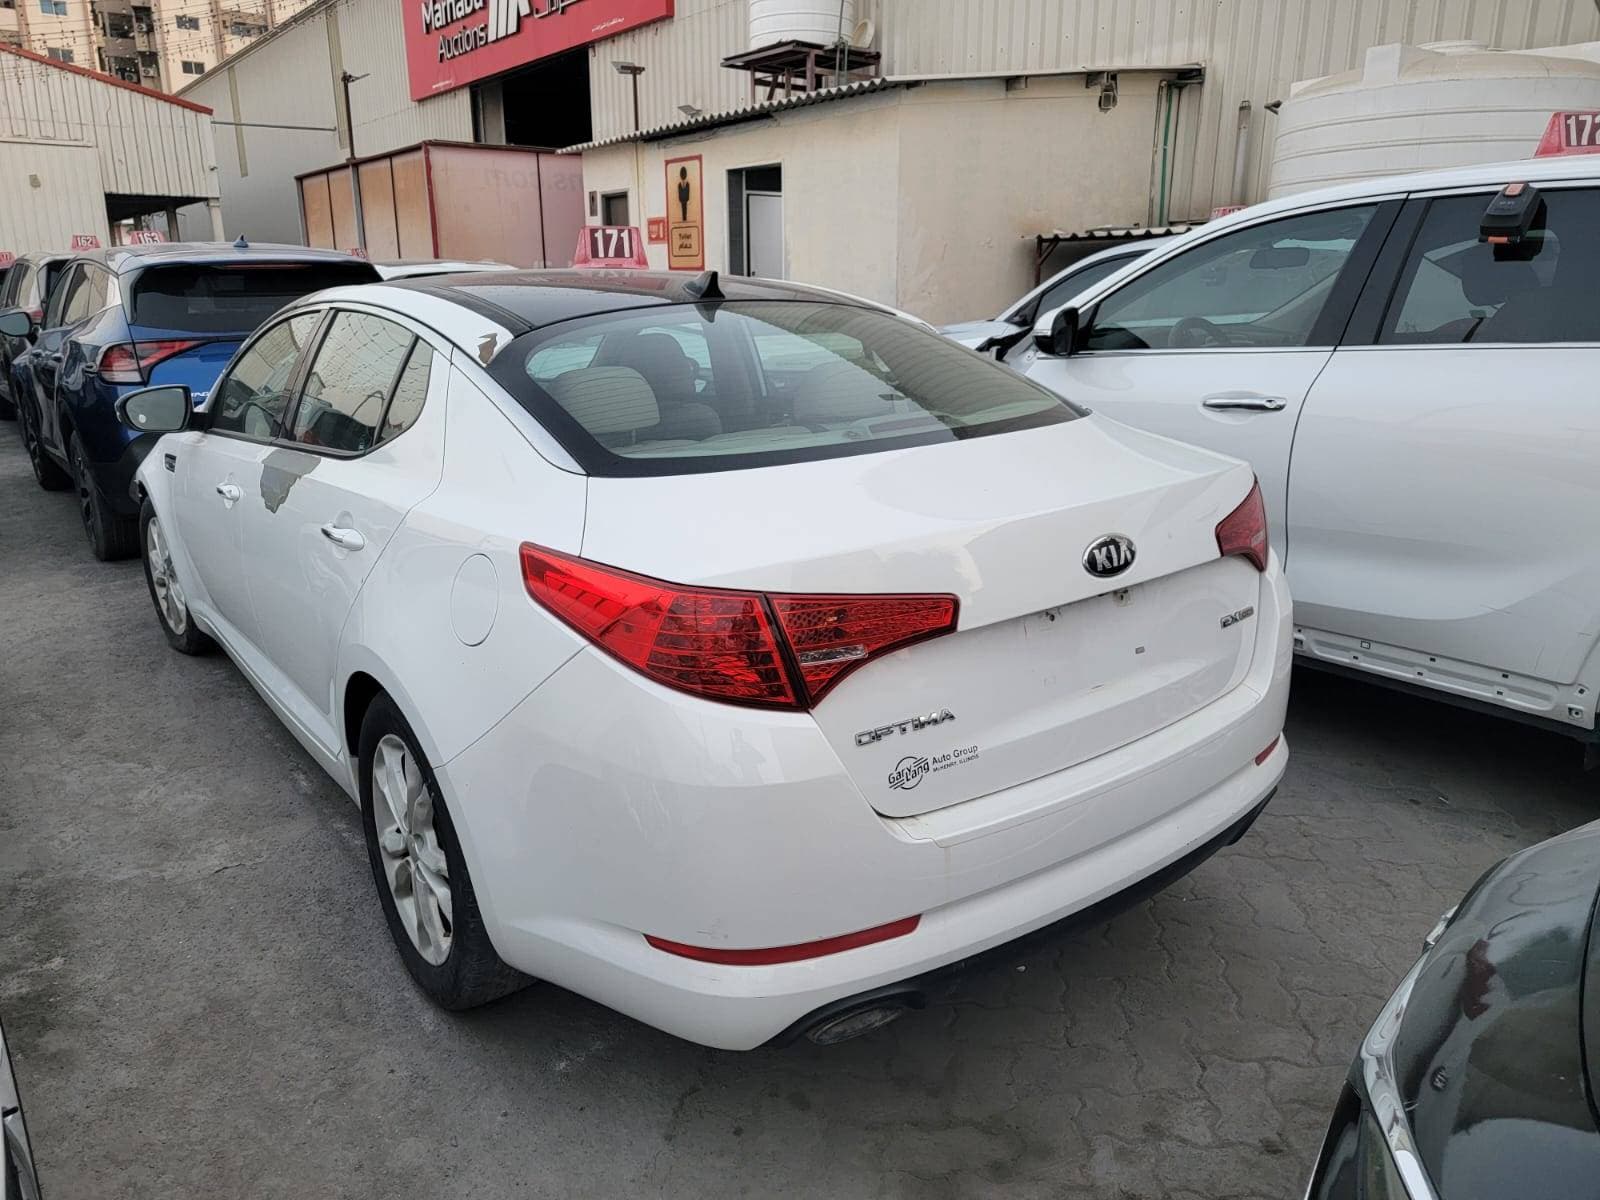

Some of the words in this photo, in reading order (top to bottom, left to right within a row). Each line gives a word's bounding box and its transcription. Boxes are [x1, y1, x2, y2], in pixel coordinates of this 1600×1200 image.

[439, 24, 486, 60] Auctions
[138, 232, 160, 244] 163
[594, 229, 631, 258] 171
[1092, 539, 1132, 572] KIA
[855, 708, 956, 746] OPTIMA
[932, 754, 951, 765] Auto
[953, 745, 978, 758] Group
[905, 761, 930, 782] Lang
